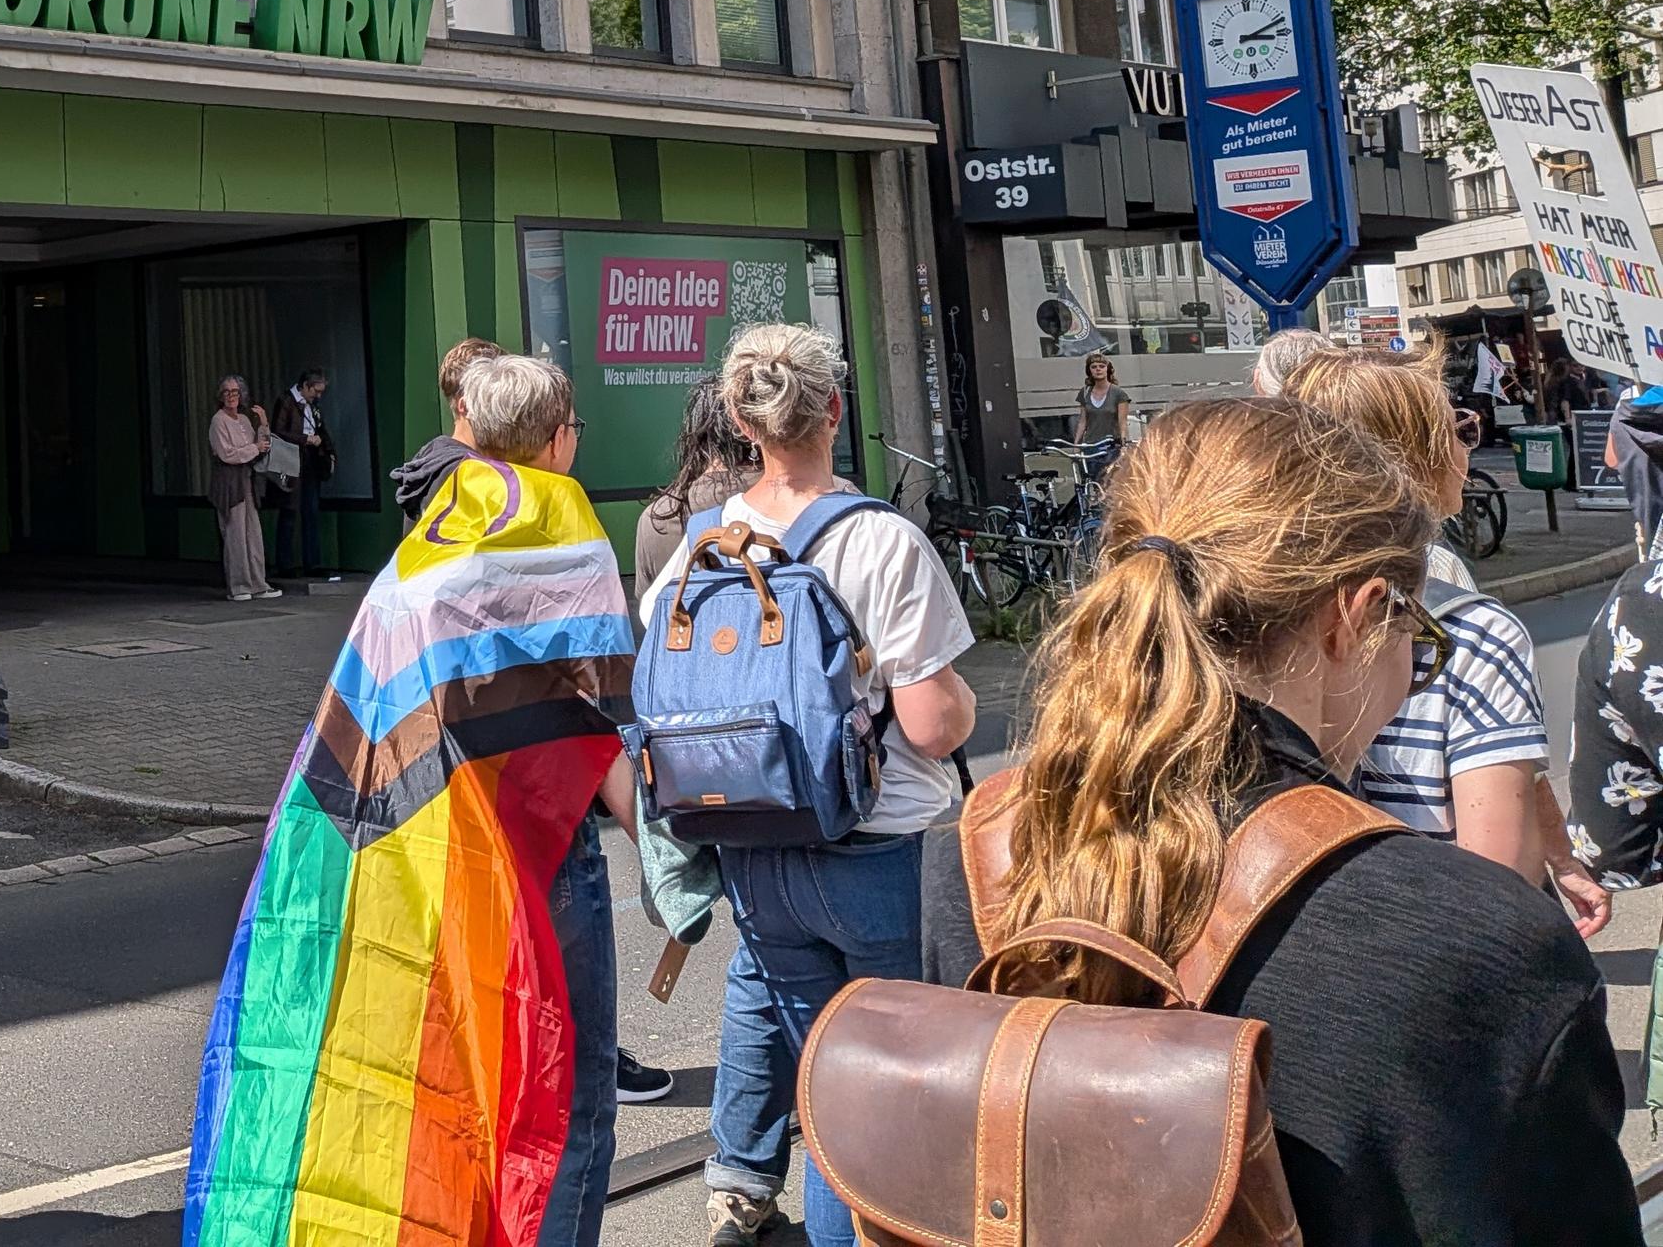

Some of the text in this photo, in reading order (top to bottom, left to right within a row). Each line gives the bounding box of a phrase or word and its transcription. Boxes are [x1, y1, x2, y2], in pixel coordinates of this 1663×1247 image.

[1476, 78, 1604, 133] DIESER AST
[1222, 125, 1297, 154] gut beraten!
[1225, 116, 1288, 139] Als Mieter
[964, 154, 1056, 182] Oststr.
[1241, 168, 1277, 178] VERHELFEN
[995, 184, 1029, 209] 39
[1533, 202, 1638, 251] HAT MEHR
[1254, 242, 1286, 252] MIETER
[1255, 250, 1287, 260] VEREIN
[1538, 240, 1663, 299] MENSCHLICHKEIT
[608, 268, 720, 308] Deine Idee
[1560, 288, 1594, 319] ALS
[605, 314, 699, 352] für NRW.
[604, 368, 625, 385] Was
[626, 367, 654, 385] willst
[655, 367, 668, 384] du
